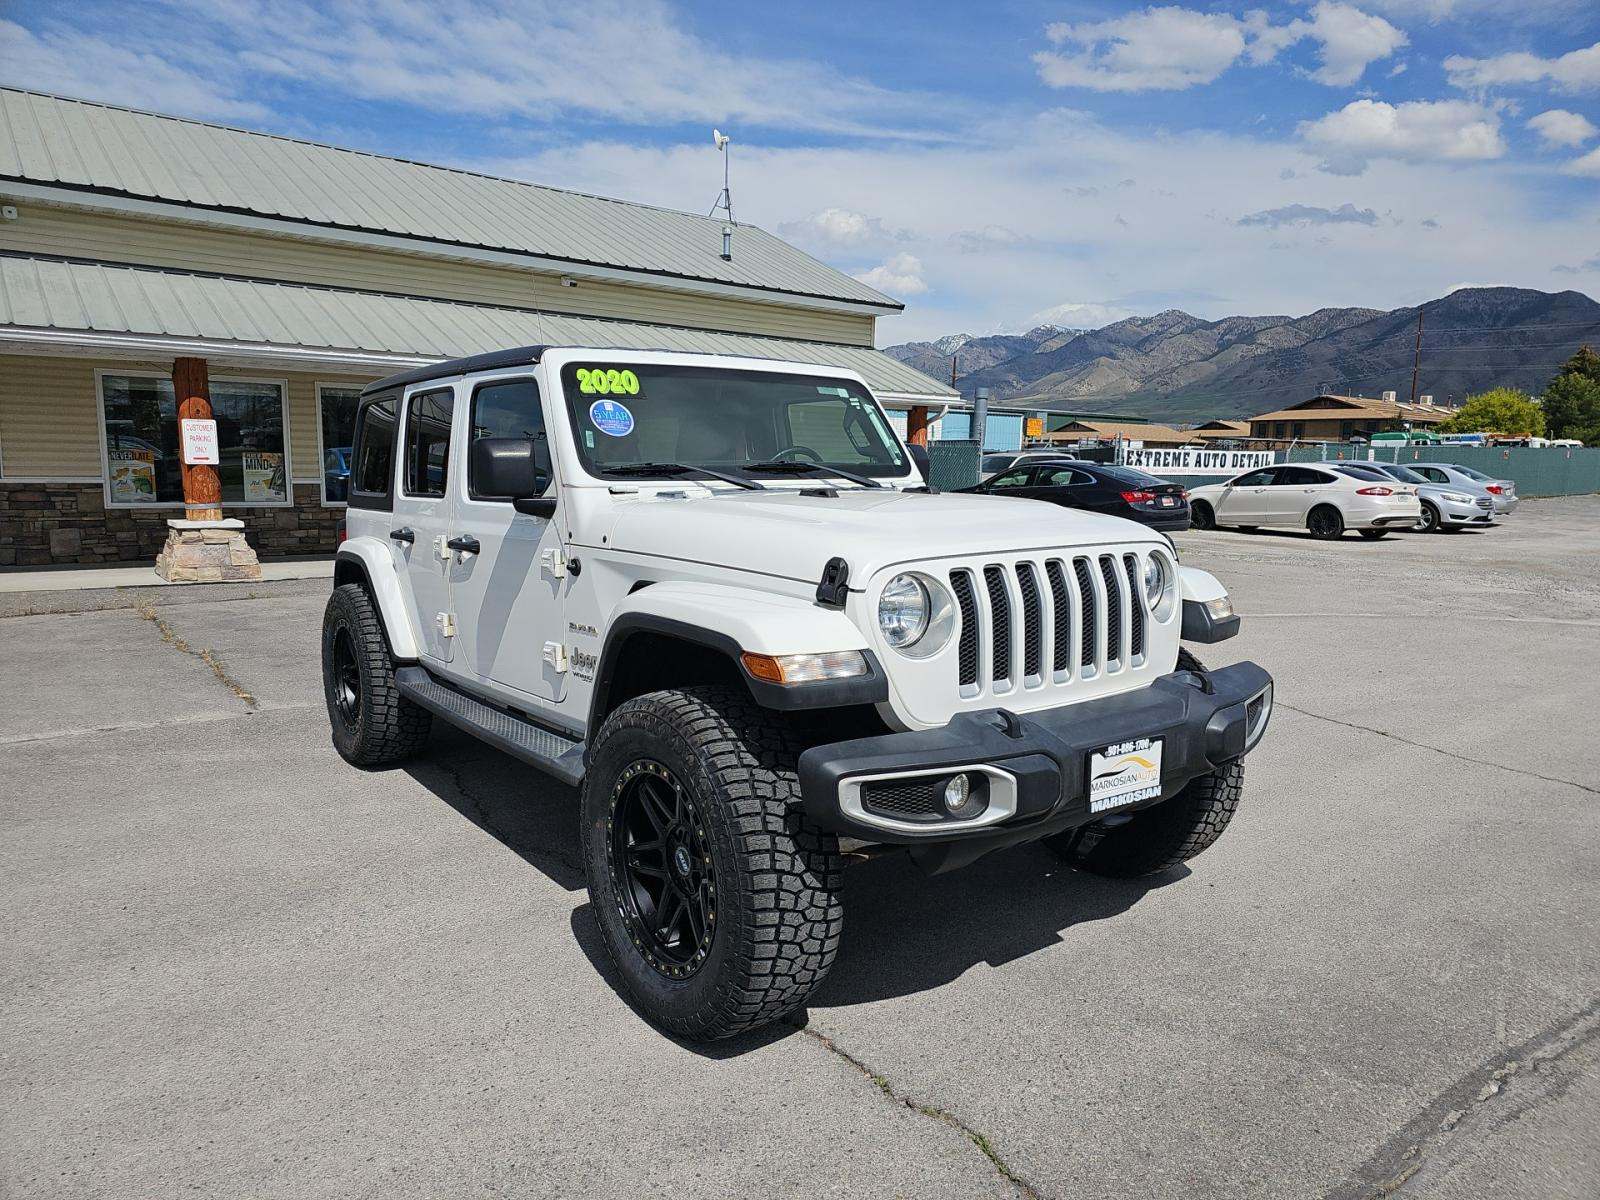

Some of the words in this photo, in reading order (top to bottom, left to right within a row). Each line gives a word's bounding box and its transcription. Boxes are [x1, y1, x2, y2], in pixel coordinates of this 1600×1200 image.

[576, 368, 640, 395] 2020
[190, 434, 212, 442] PARKING
[1126, 450, 1190, 468] EXTREME
[1195, 451, 1226, 468] AUTO
[1231, 452, 1271, 468] DETAIL
[1091, 785, 1162, 814] MARKOSIAN
